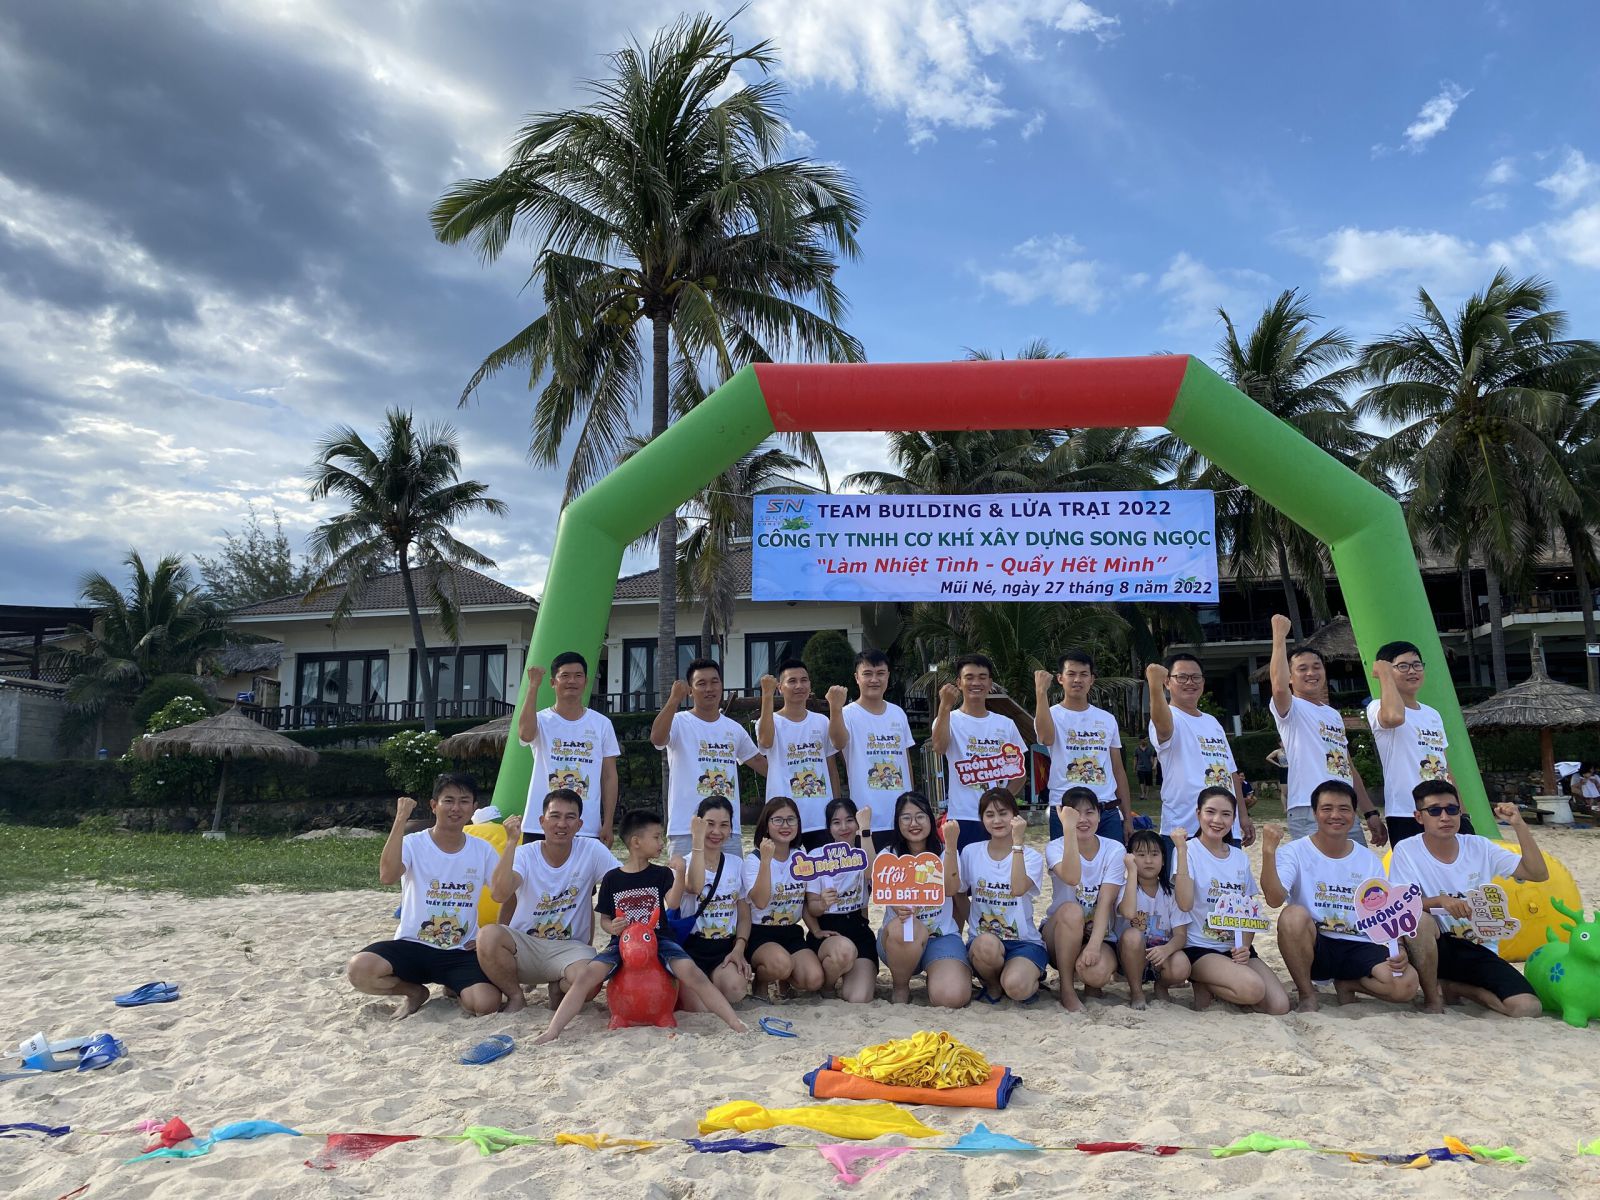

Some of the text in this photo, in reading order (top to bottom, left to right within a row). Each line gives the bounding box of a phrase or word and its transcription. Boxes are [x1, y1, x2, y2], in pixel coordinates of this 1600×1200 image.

[766, 499, 804, 513] SN
[818, 498, 1171, 520] TEAM BUILDING & LỬA TRẠI 2022
[758, 528, 1210, 549] CÔNG TY TNHH CƠ KHÍ XÂY DỰNG SONG NGỌC
[875, 558, 928, 576] Nhiệt
[936, 556, 978, 572] Tình
[1001, 554, 1054, 576] Quẩy
[1061, 556, 1098, 572] Hết
[941, 580, 1212, 596] Mũi Né, ngày 27 tháng 8 năm 2022
[958, 756, 988, 772] TRỐN
[962, 773, 975, 782] ĐI
[877, 866, 907, 886] Hội
[442, 882, 466, 890] LÀM
[896, 887, 920, 900] BẤT
[924, 885, 940, 900] TỬ
[988, 882, 1010, 890] LÀM
[1220, 882, 1241, 890] LÀM
[1357, 883, 1422, 931] KHÔNG SỢ
[1210, 915, 1269, 930] WE ARE FAMILY
[1381, 910, 1417, 939] VỢ
